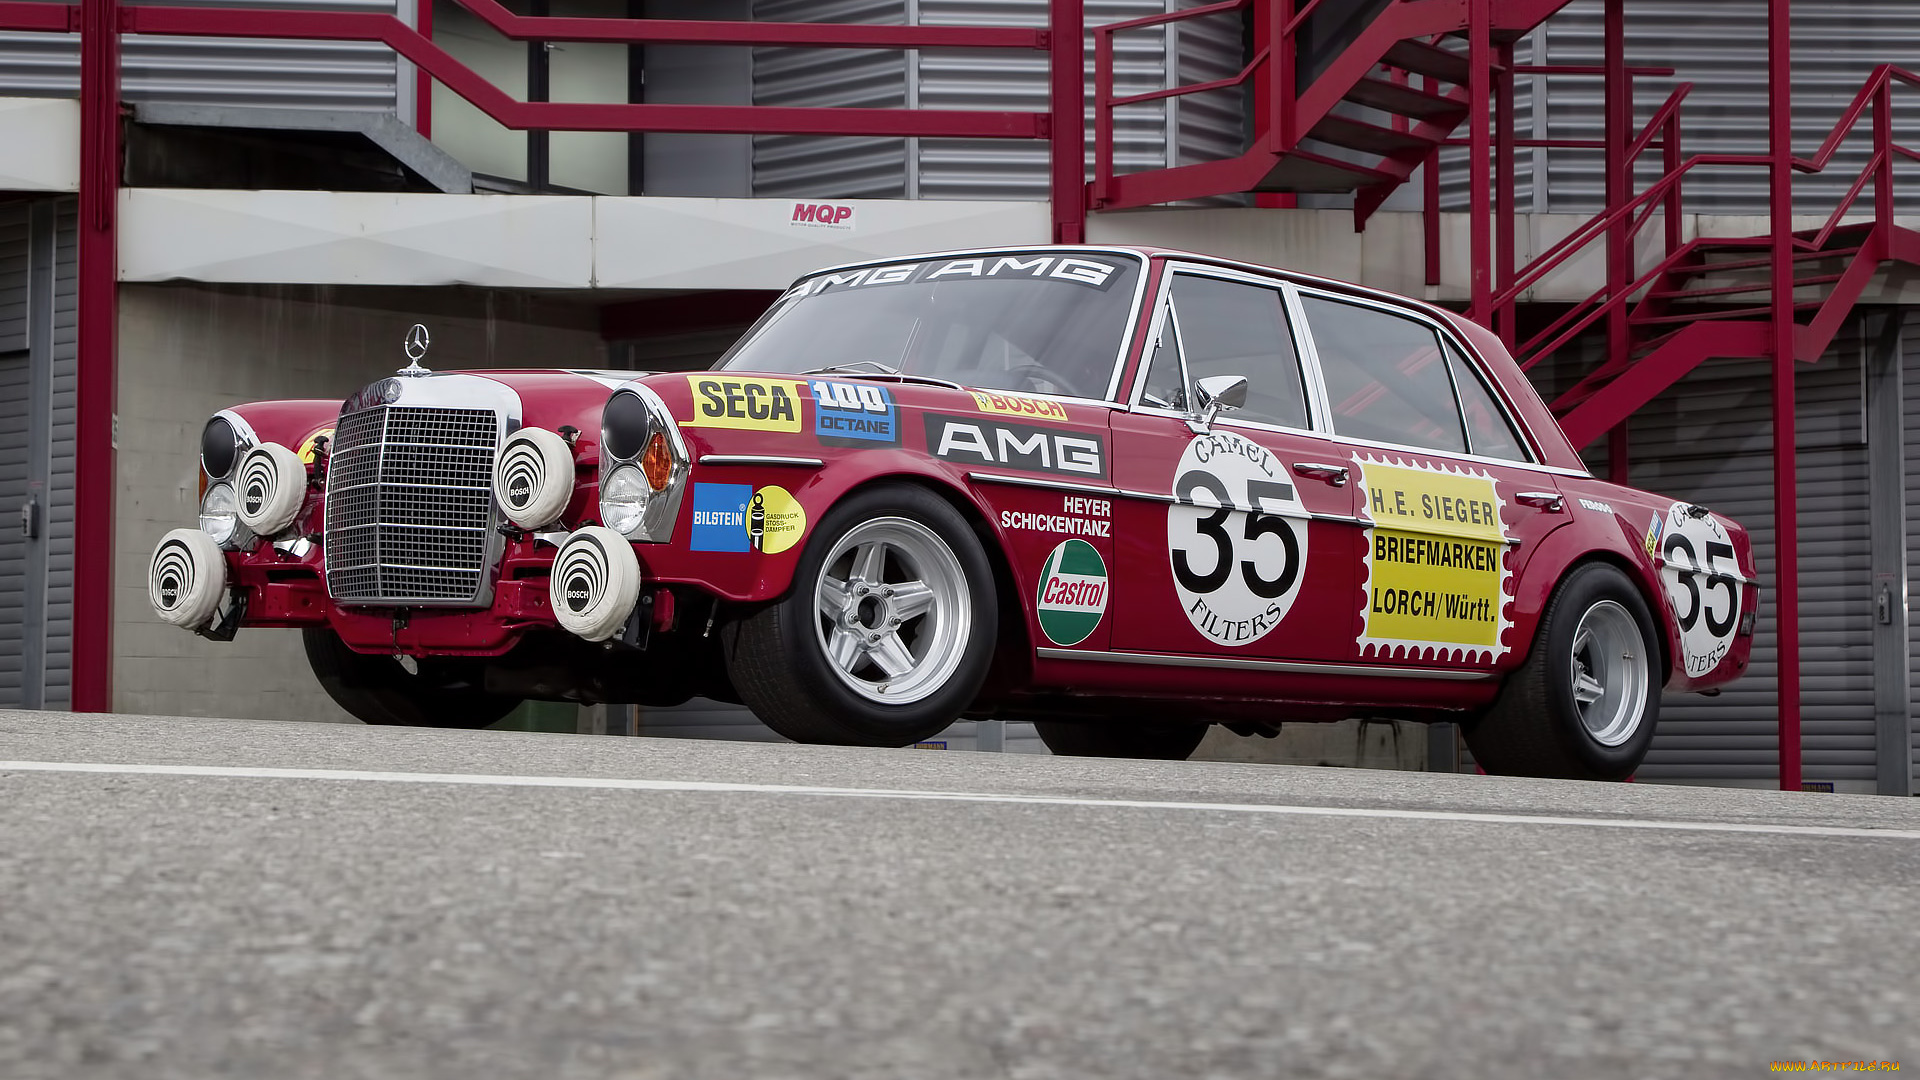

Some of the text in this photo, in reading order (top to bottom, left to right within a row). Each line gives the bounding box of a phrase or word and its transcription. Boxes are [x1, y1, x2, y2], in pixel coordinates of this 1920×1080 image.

[792, 204, 851, 224] MQP
[926, 257, 1116, 286] AMG
[699, 381, 795, 421] SECA
[813, 381, 888, 414] 100
[990, 394, 1064, 418] BOSCH
[821, 416, 890, 435] OCTANE
[937, 422, 1101, 474] AMG
[1194, 435, 1273, 478] CAMEL
[246, 496, 262, 504] BOSCH
[510, 487, 529, 496] BOSCH
[694, 511, 743, 526] BILSTEIN
[766, 512, 799, 520] GASDRUCK
[1064, 496, 1111, 517] HEYER
[1371, 488, 1494, 526] H.E. SIEGER
[1001, 511, 1111, 537] SCHICKENTANZ
[1172, 469, 1300, 598] 35
[1375, 535, 1496, 572] BRIEFMARKEN
[162, 588, 178, 596] BOSCH
[567, 590, 589, 599] BOSCH
[1044, 576, 1107, 606] Castrol
[1664, 533, 1738, 638] 35
[1190, 597, 1281, 641] FILTERS
[1373, 587, 1495, 622] LORCH/Württ.
